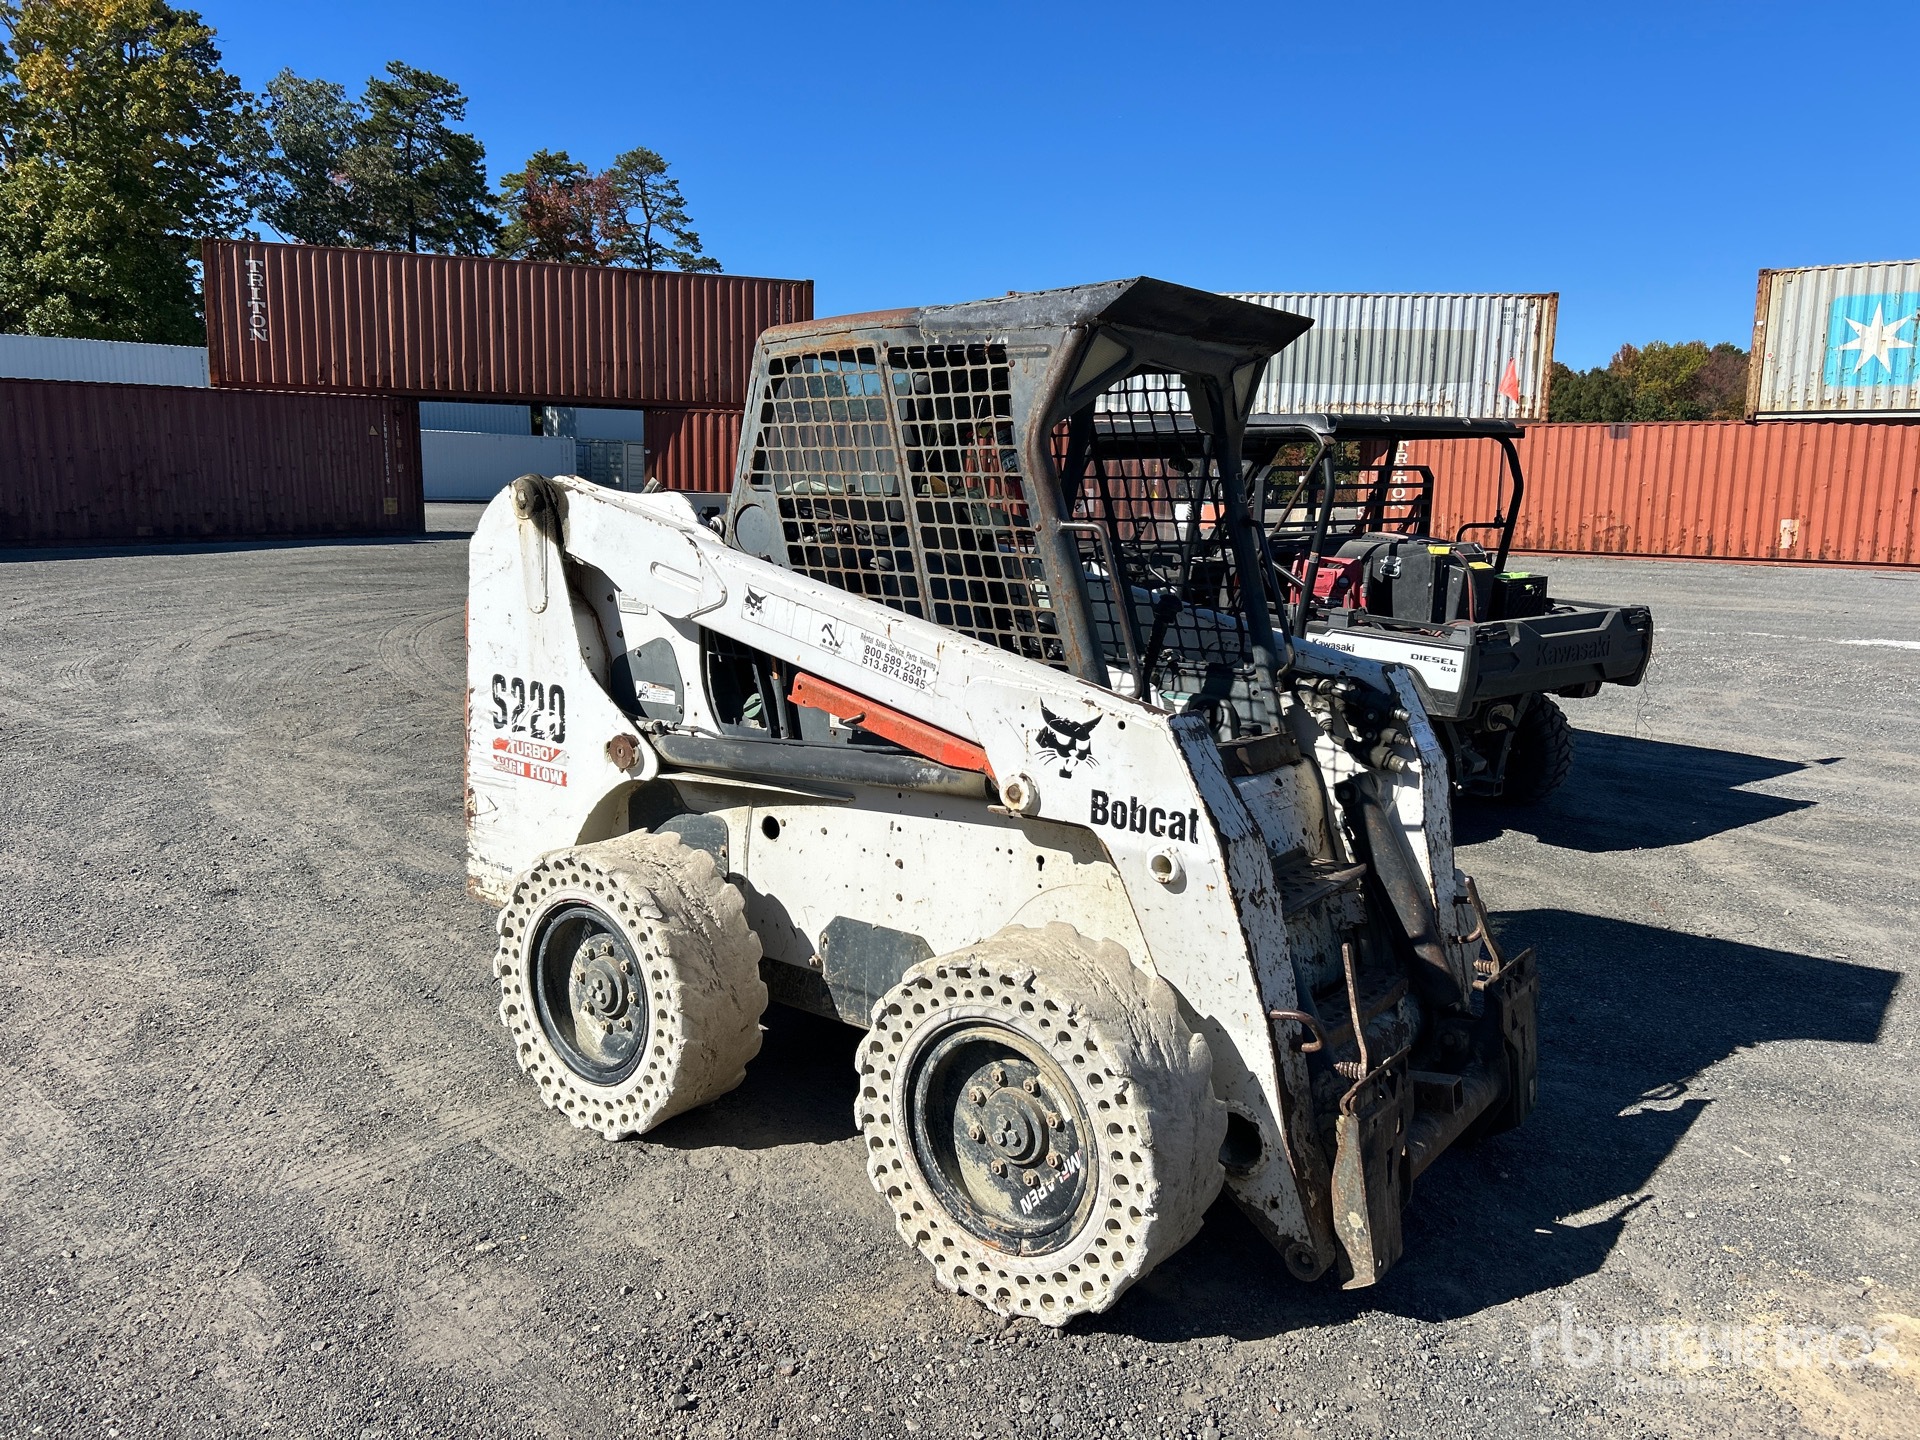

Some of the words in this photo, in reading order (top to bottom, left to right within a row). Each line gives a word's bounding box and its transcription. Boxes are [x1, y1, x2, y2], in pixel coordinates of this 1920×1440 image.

[245, 259, 268, 342] TRITON
[864, 644, 928, 679] 800.589.2281
[875, 638, 887, 650] Sales
[888, 644, 905, 656] Service
[906, 651, 918, 663] Parts
[1311, 637, 1355, 653] Kawasaki
[1410, 653, 1458, 667] DIESEL
[1536, 634, 1611, 667] Kawasaki
[862, 655, 926, 690] 513.874.8945
[492, 673, 565, 744] S220
[508, 740, 550, 761] TURBO
[530, 764, 563, 785] FLOW
[1090, 789, 1199, 844] Bobcat
